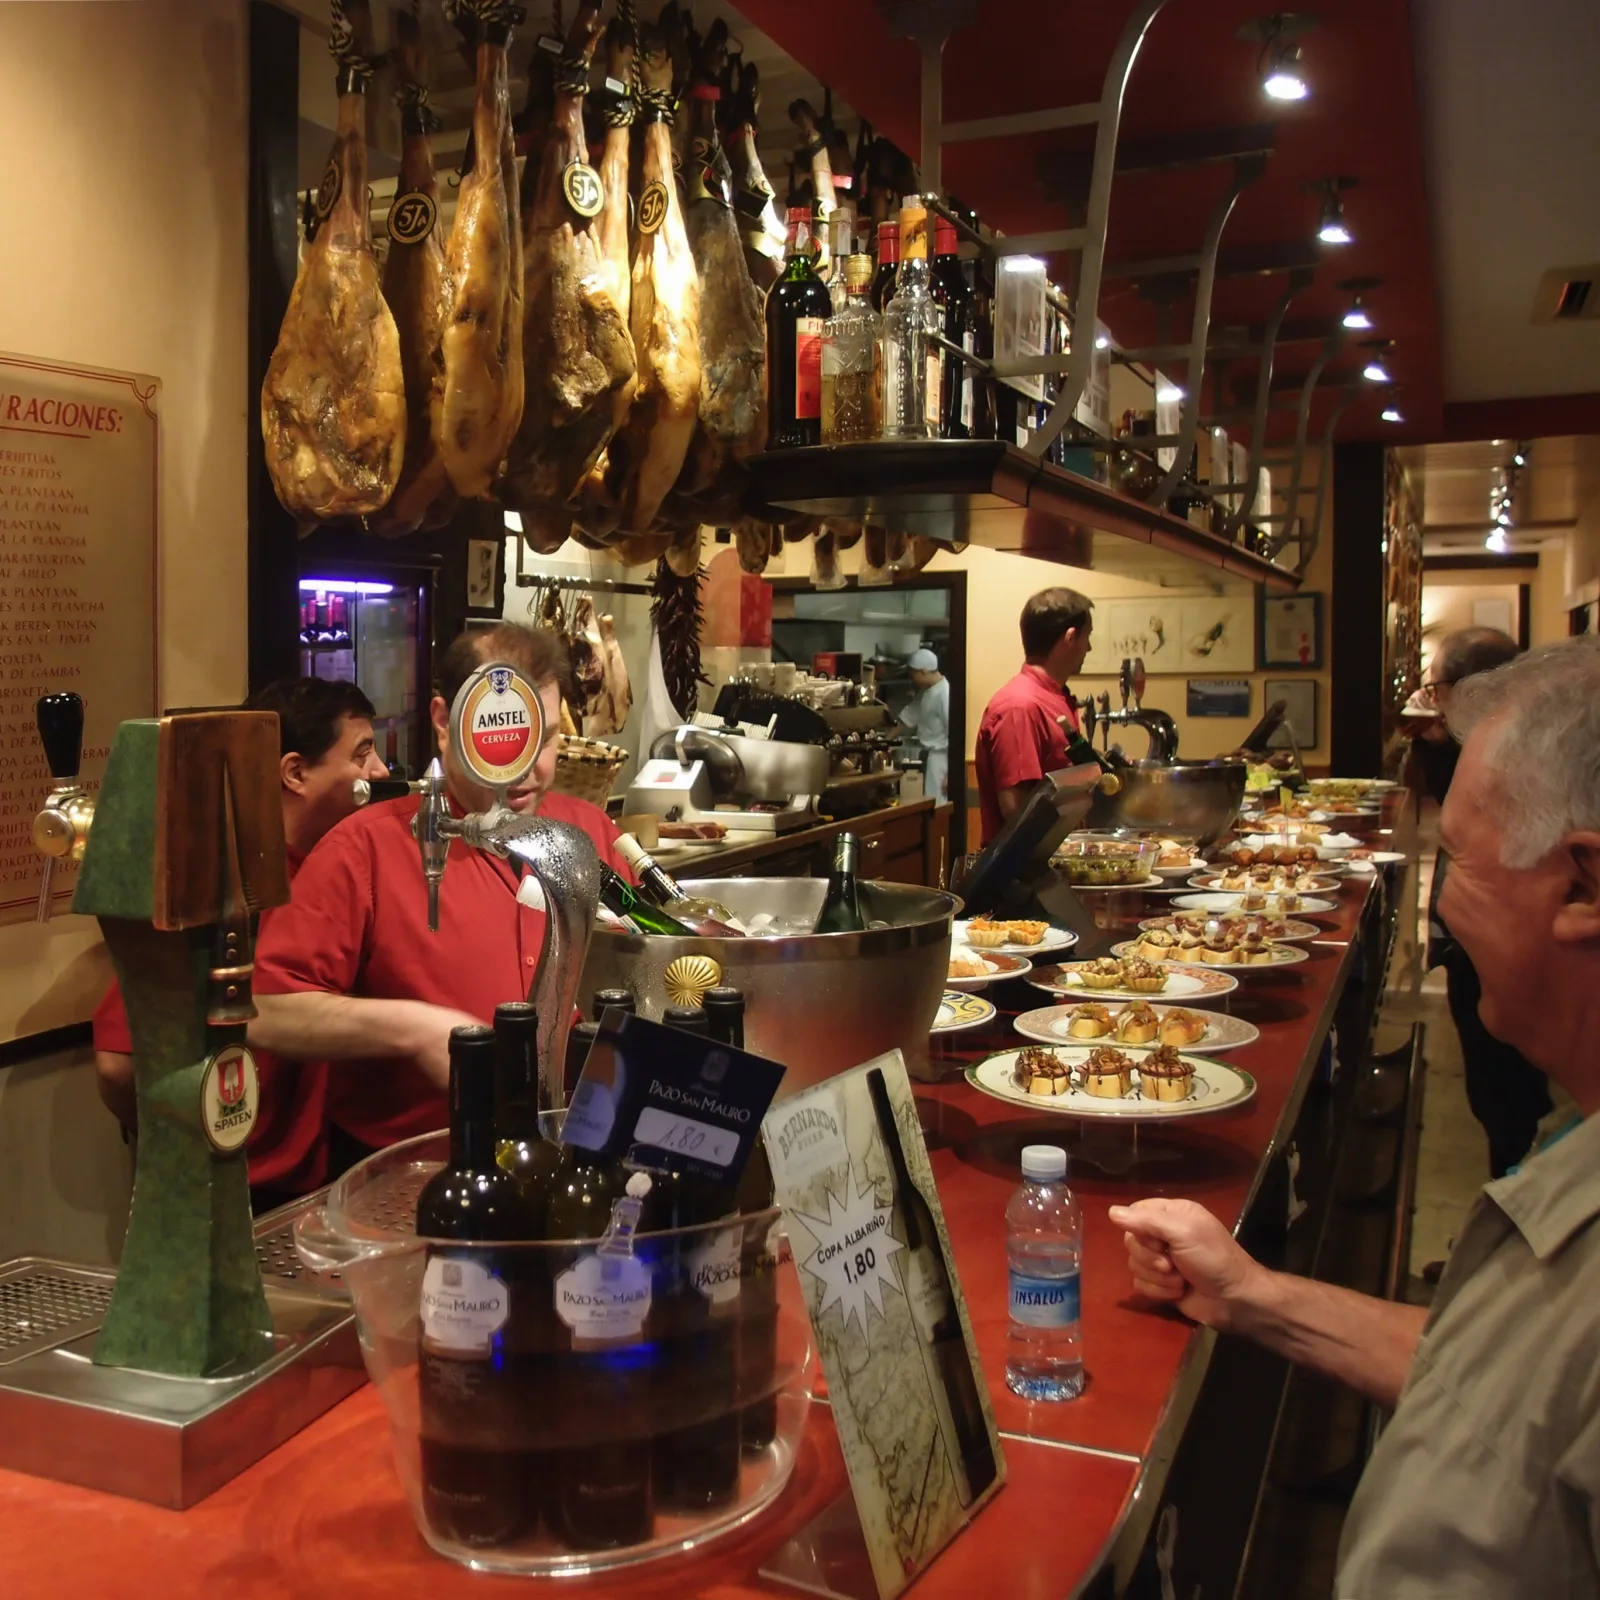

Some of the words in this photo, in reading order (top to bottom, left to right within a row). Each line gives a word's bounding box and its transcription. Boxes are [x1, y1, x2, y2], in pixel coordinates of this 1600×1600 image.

[21, 467, 62, 480] FRITOS
[35, 502, 89, 516] PLANCHA
[33, 535, 87, 549] PLANCHA
[15, 587, 77, 598] PLANTXAN
[52, 602, 105, 613] PLANCHA
[15, 620, 51, 631] BEREN
[57, 620, 98, 631] TINTAN
[59, 633, 91, 645] TINTA
[11, 669, 25, 680] DE
[31, 667, 82, 678] GAMBAS
[478, 710, 525, 728] AMSTEL
[481, 732, 520, 744] CERVEZA
[649, 1079, 681, 1101] PAZO
[681, 1093, 701, 1109] SAN
[701, 1097, 750, 1122] MAURO
[214, 1110, 252, 1132] SPATEN
[778, 1107, 838, 1160] BERNARDO
[816, 1243, 843, 1264] COPA
[844, 1215, 886, 1249] ALBARIÑO
[843, 1247, 876, 1284] 1,80
[563, 1290, 592, 1306] PAZO
[1015, 1289, 1065, 1306] INSALUS
[453, 1299, 500, 1312] MAURO
